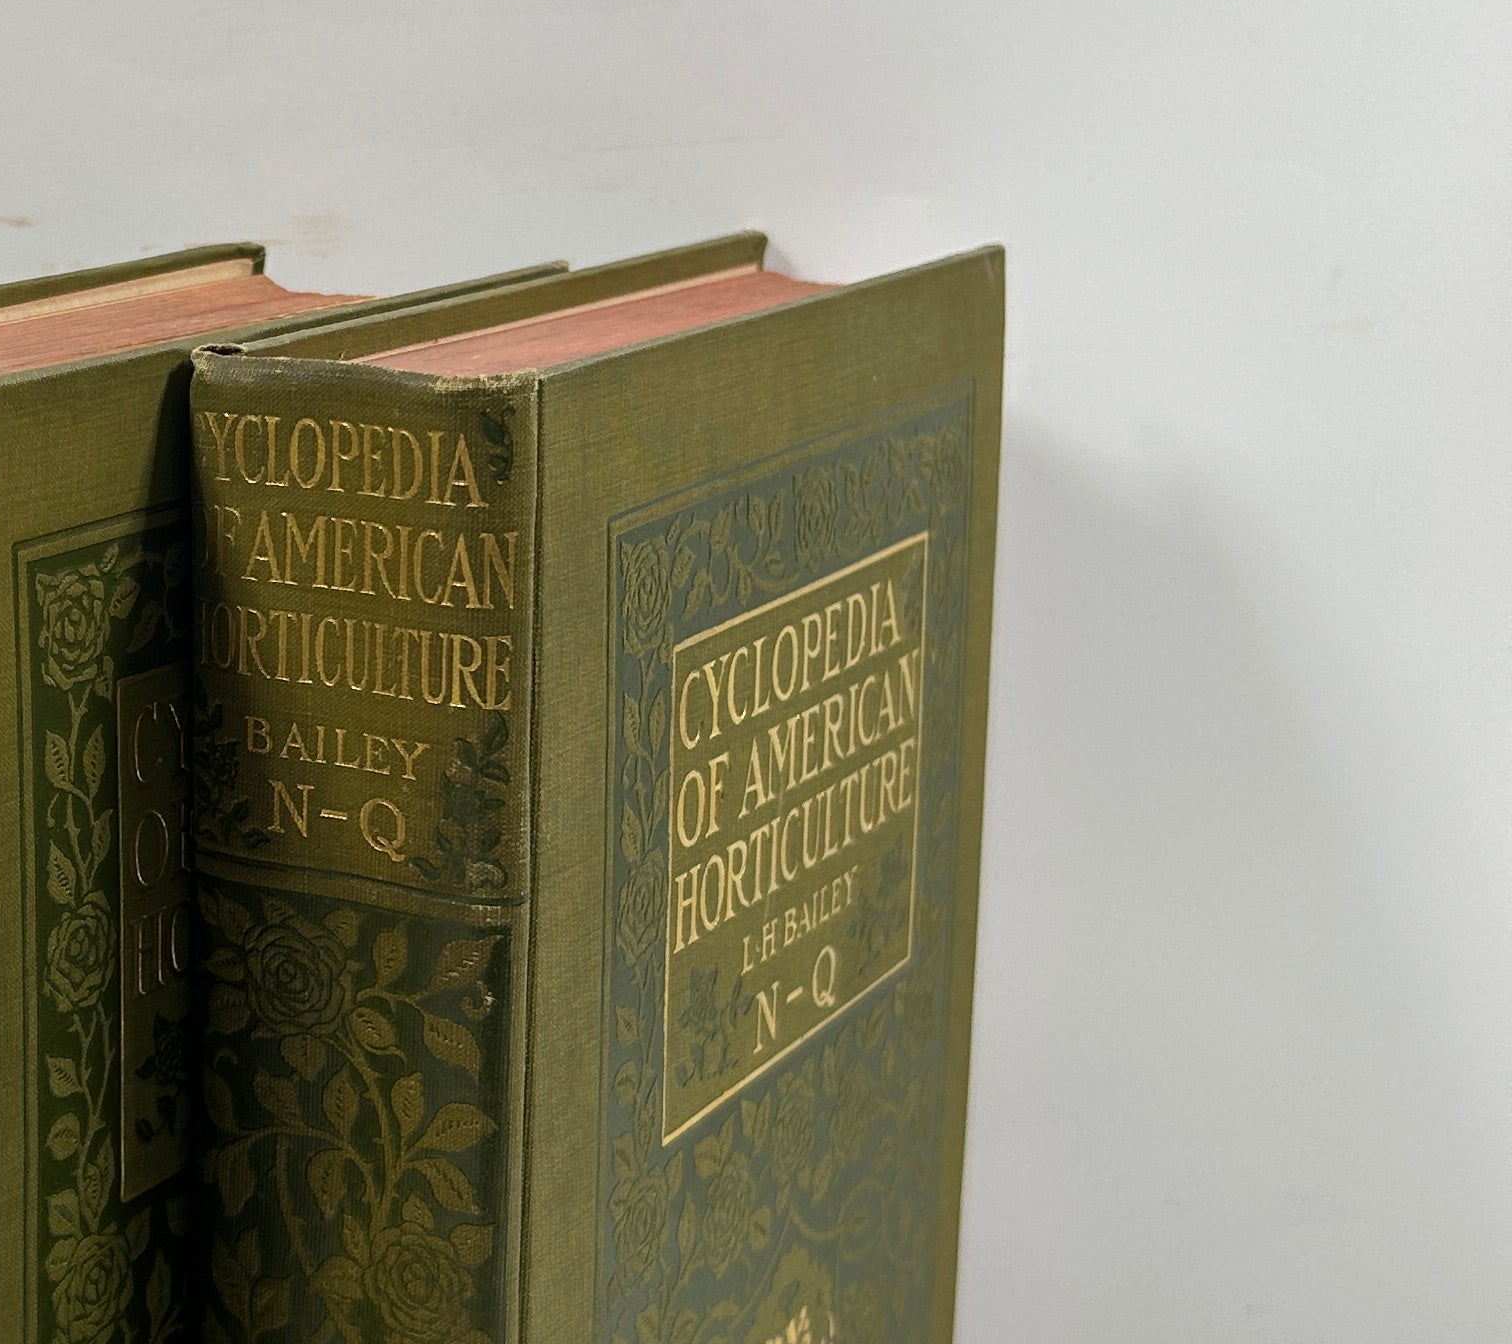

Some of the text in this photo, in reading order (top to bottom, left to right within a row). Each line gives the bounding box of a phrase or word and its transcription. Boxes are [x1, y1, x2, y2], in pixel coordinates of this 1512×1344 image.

[195, 411, 490, 508] YCLOPEDIA
[241, 511, 520, 610] AMERICAN
[679, 576, 903, 754] CYCLOPEDIA
[243, 714, 431, 783] BAILEY
[675, 648, 922, 849] OF AMERICAN
[672, 735, 917, 955] HORTICULTURE
[783, 864, 859, 948] BAILEY
